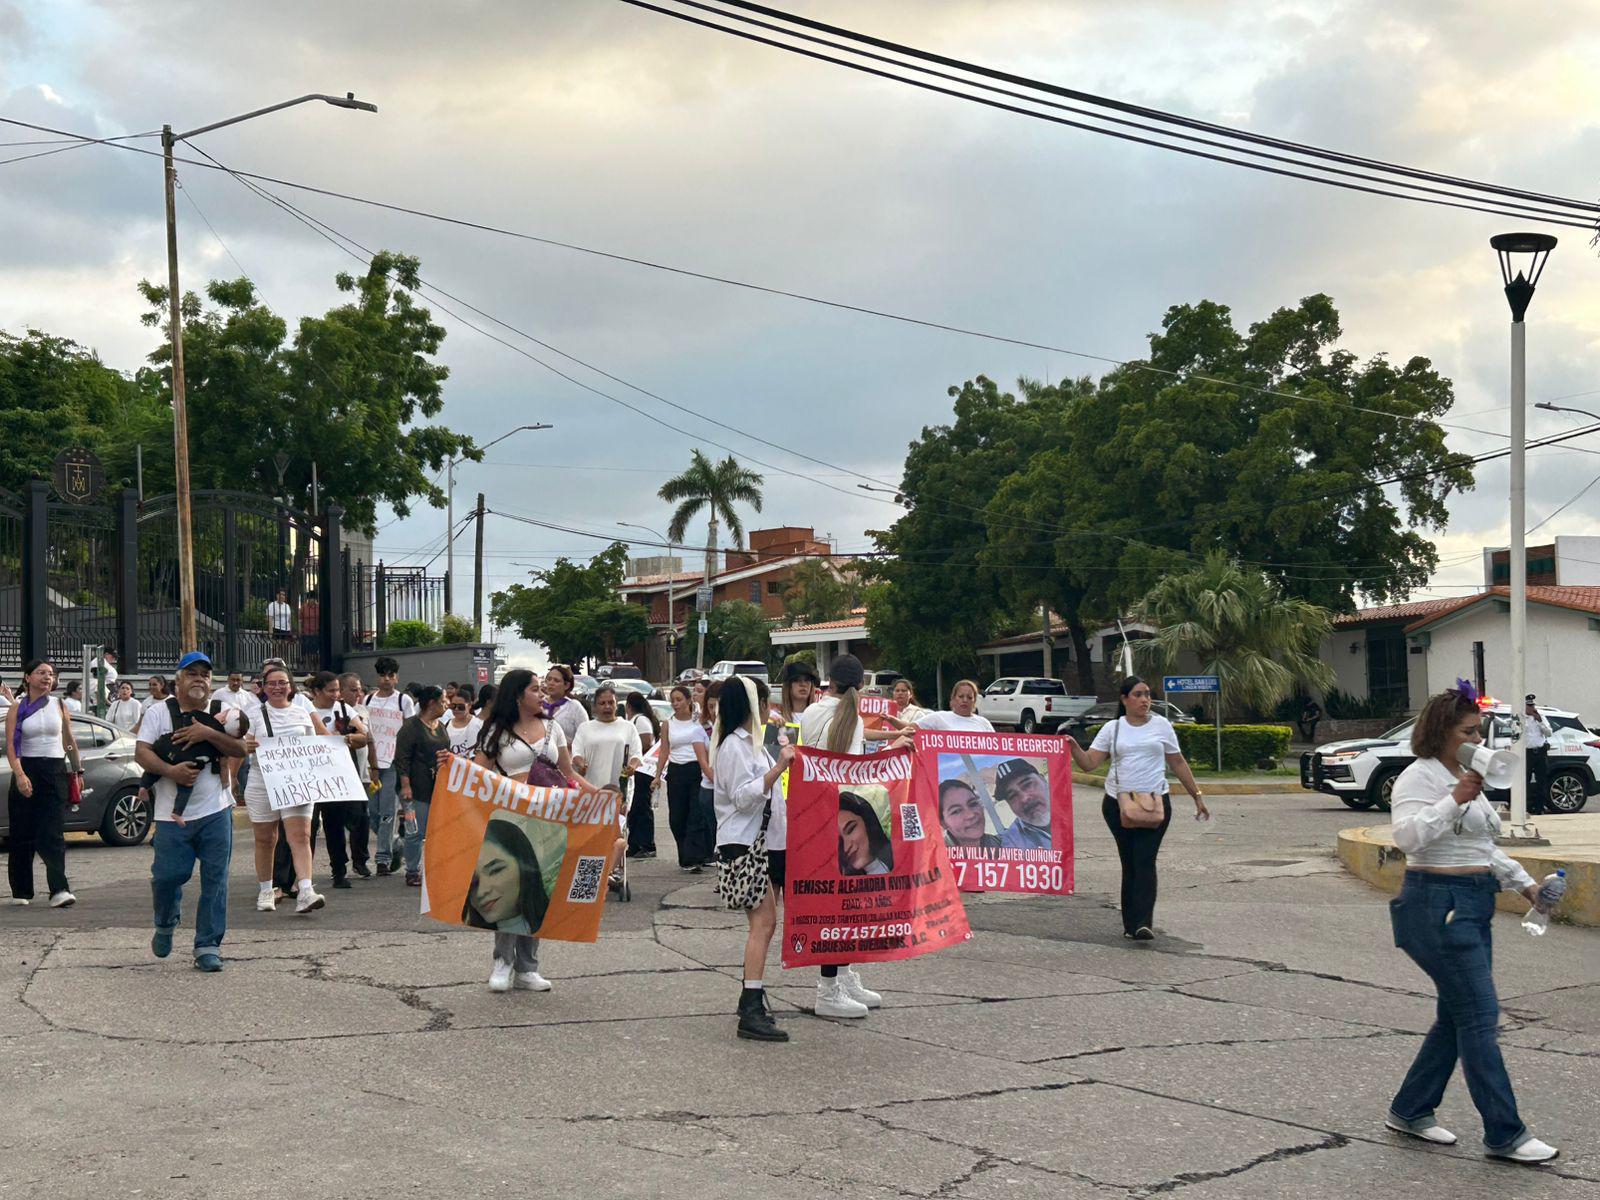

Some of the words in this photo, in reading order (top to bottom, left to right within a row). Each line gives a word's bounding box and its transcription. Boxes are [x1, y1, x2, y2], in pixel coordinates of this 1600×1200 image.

[289, 736, 301, 746] LOS
[946, 735, 999, 751] QUEREMOS
[1001, 738, 1014, 752] DE
[1016, 739, 1064, 754] REGRESO!
[261, 764, 273, 774] NO
[276, 762, 286, 772] SE
[283, 775, 294, 784] SE
[446, 756, 618, 825] DESAPARECIDA
[966, 847, 989, 861] VILLA
[989, 848, 996, 861] Y
[997, 848, 1024, 862] JAVIER
[974, 862, 1009, 888] 157
[1016, 864, 1063, 891] 1930
[820, 922, 912, 940] 6671571930
